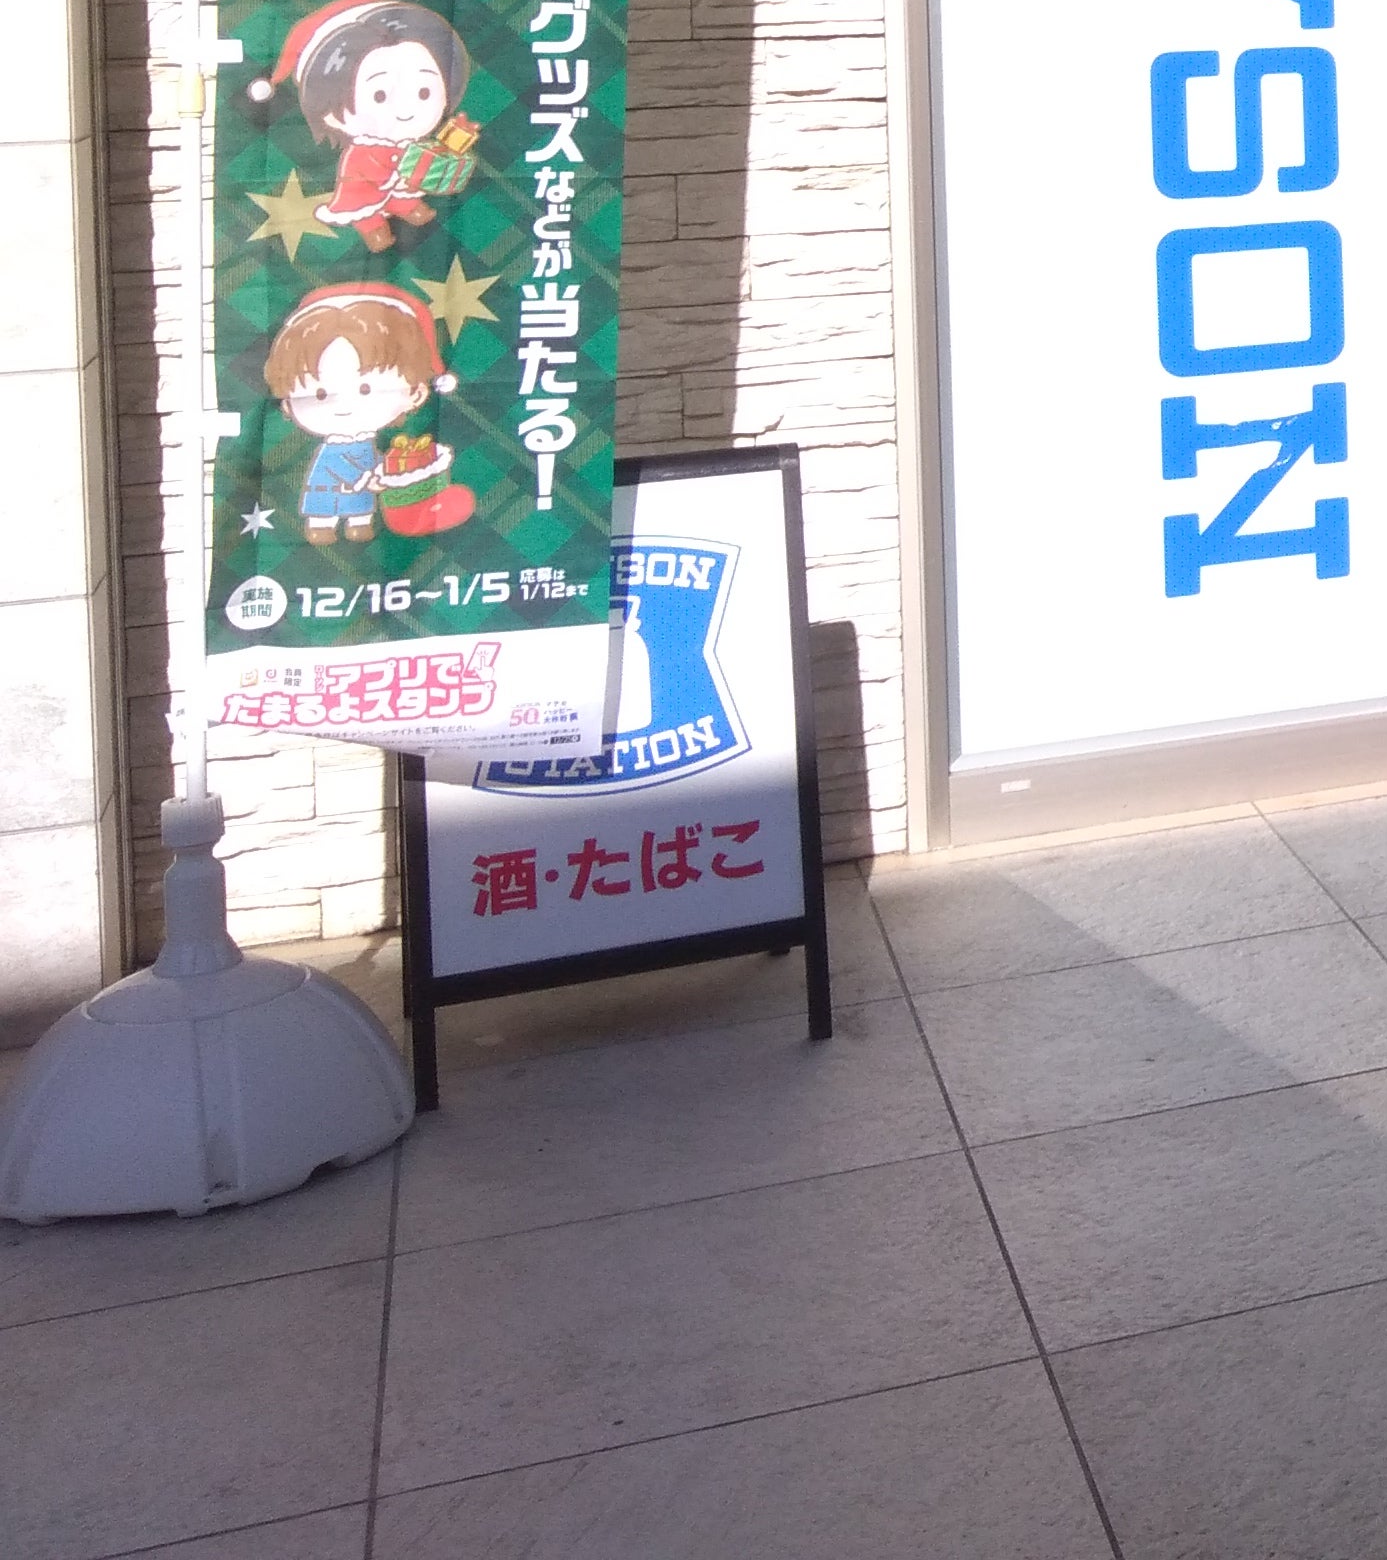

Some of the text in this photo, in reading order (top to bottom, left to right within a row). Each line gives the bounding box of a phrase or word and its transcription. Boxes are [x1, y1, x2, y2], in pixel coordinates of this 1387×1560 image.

[519, 567, 566, 584] 応募は
[611, 551, 716, 591] SON
[241, 587, 274, 603] 実施
[519, 582, 590, 601] 1/12まで
[241, 603, 273, 619] 期間
[326, 653, 464, 695] アプリで
[221, 681, 497, 728] たまるよスタンプ
[471, 819, 765, 918] 酒・たばこ
